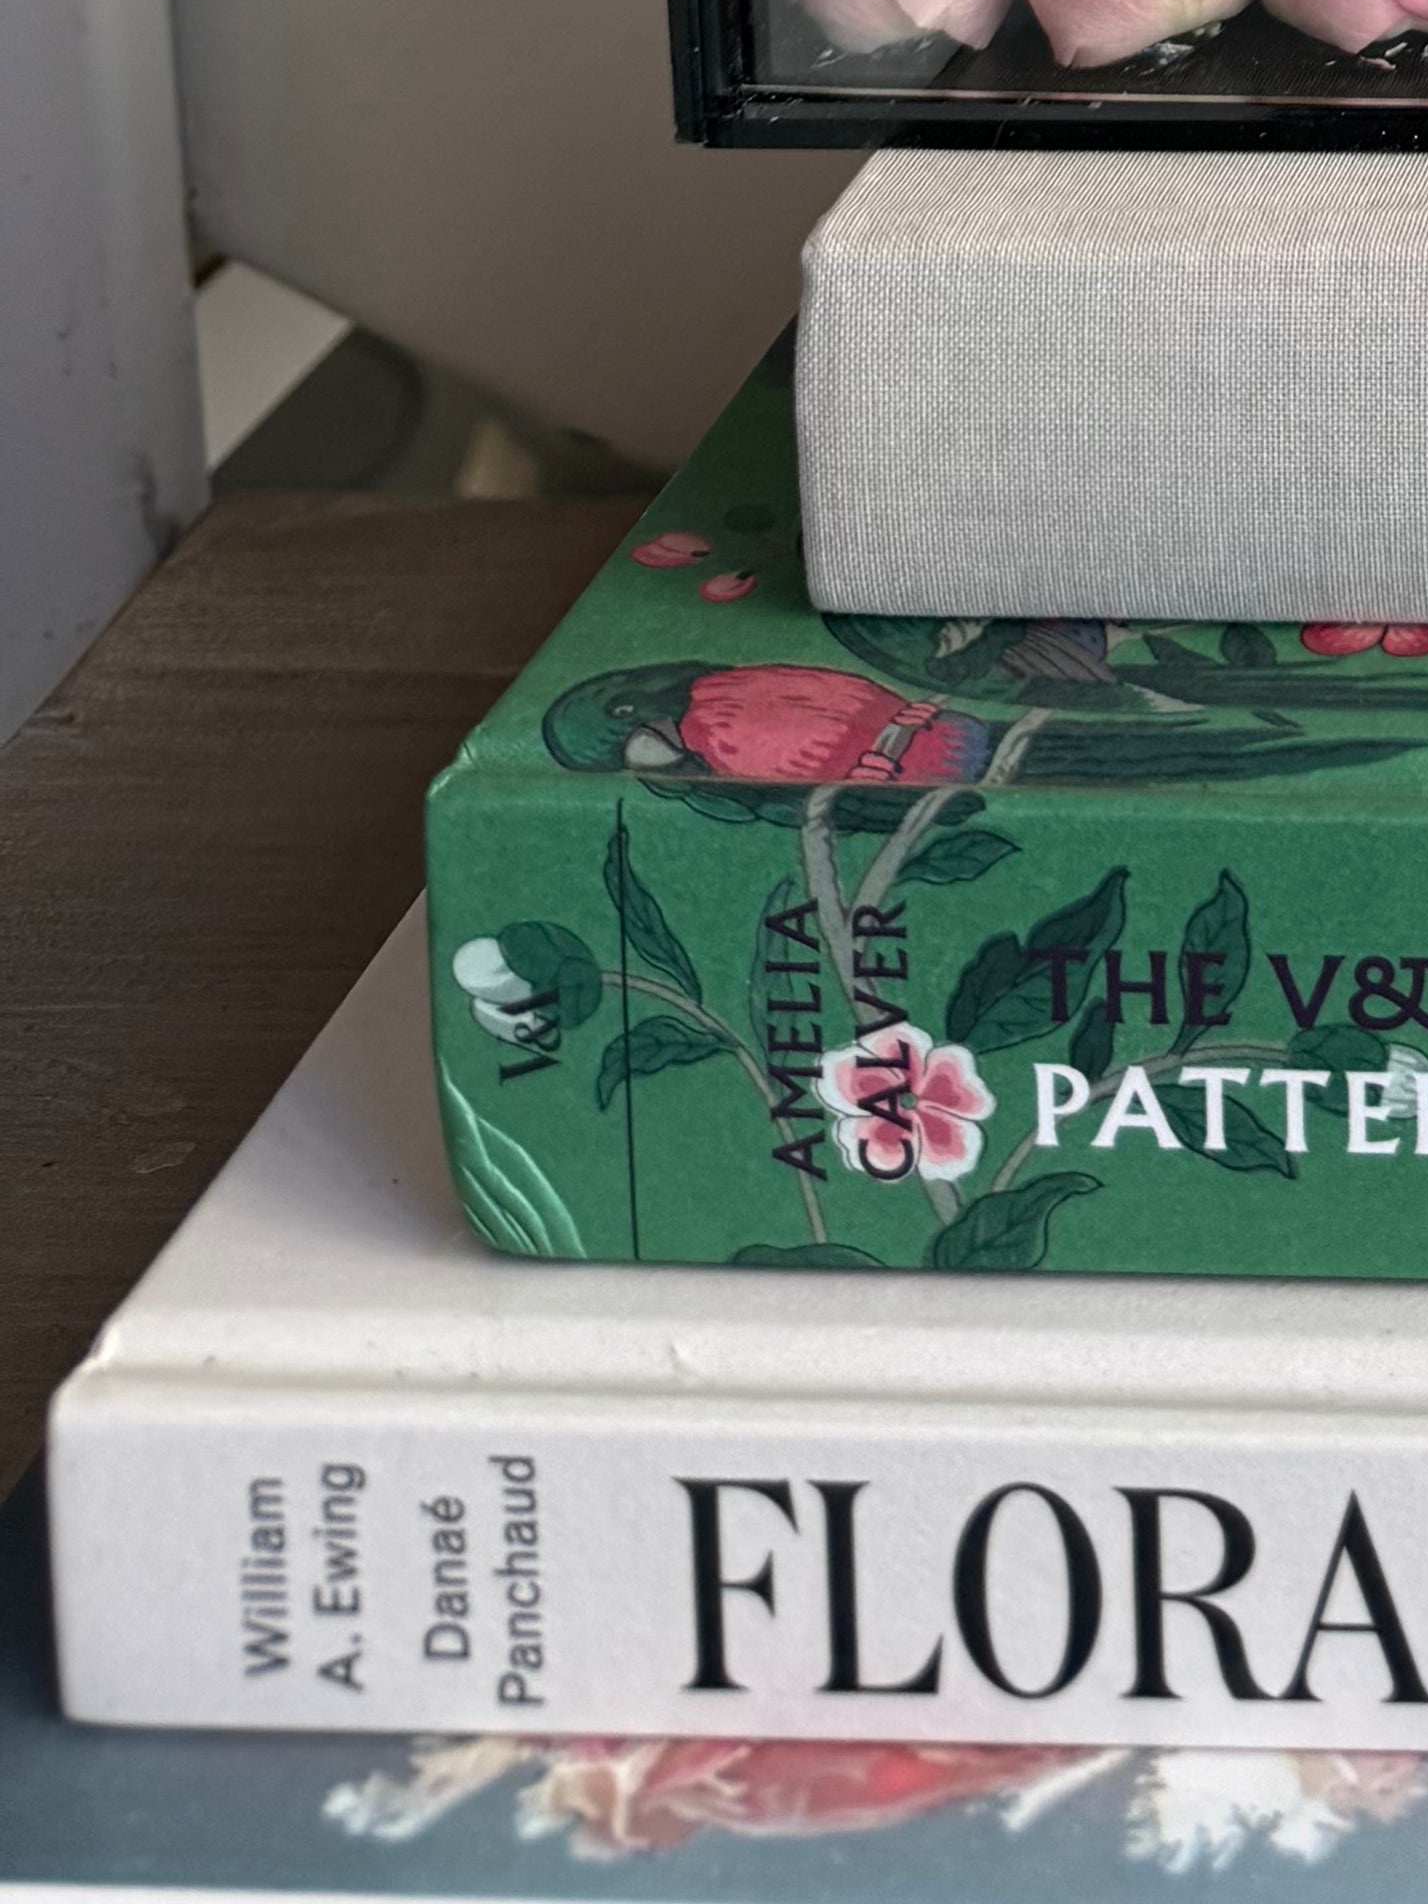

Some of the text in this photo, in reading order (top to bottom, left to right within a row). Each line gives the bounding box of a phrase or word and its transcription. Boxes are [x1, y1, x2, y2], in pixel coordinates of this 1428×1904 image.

[765, 898, 828, 1181] AMELIA
[852, 900, 914, 1180] CALVER
[1027, 948, 1233, 1027] THE
[241, 1477, 292, 1678] William
[312, 1462, 367, 1693] A. Ewing
[420, 1493, 472, 1663] Danaé
[489, 1454, 546, 1708] Panchaud
